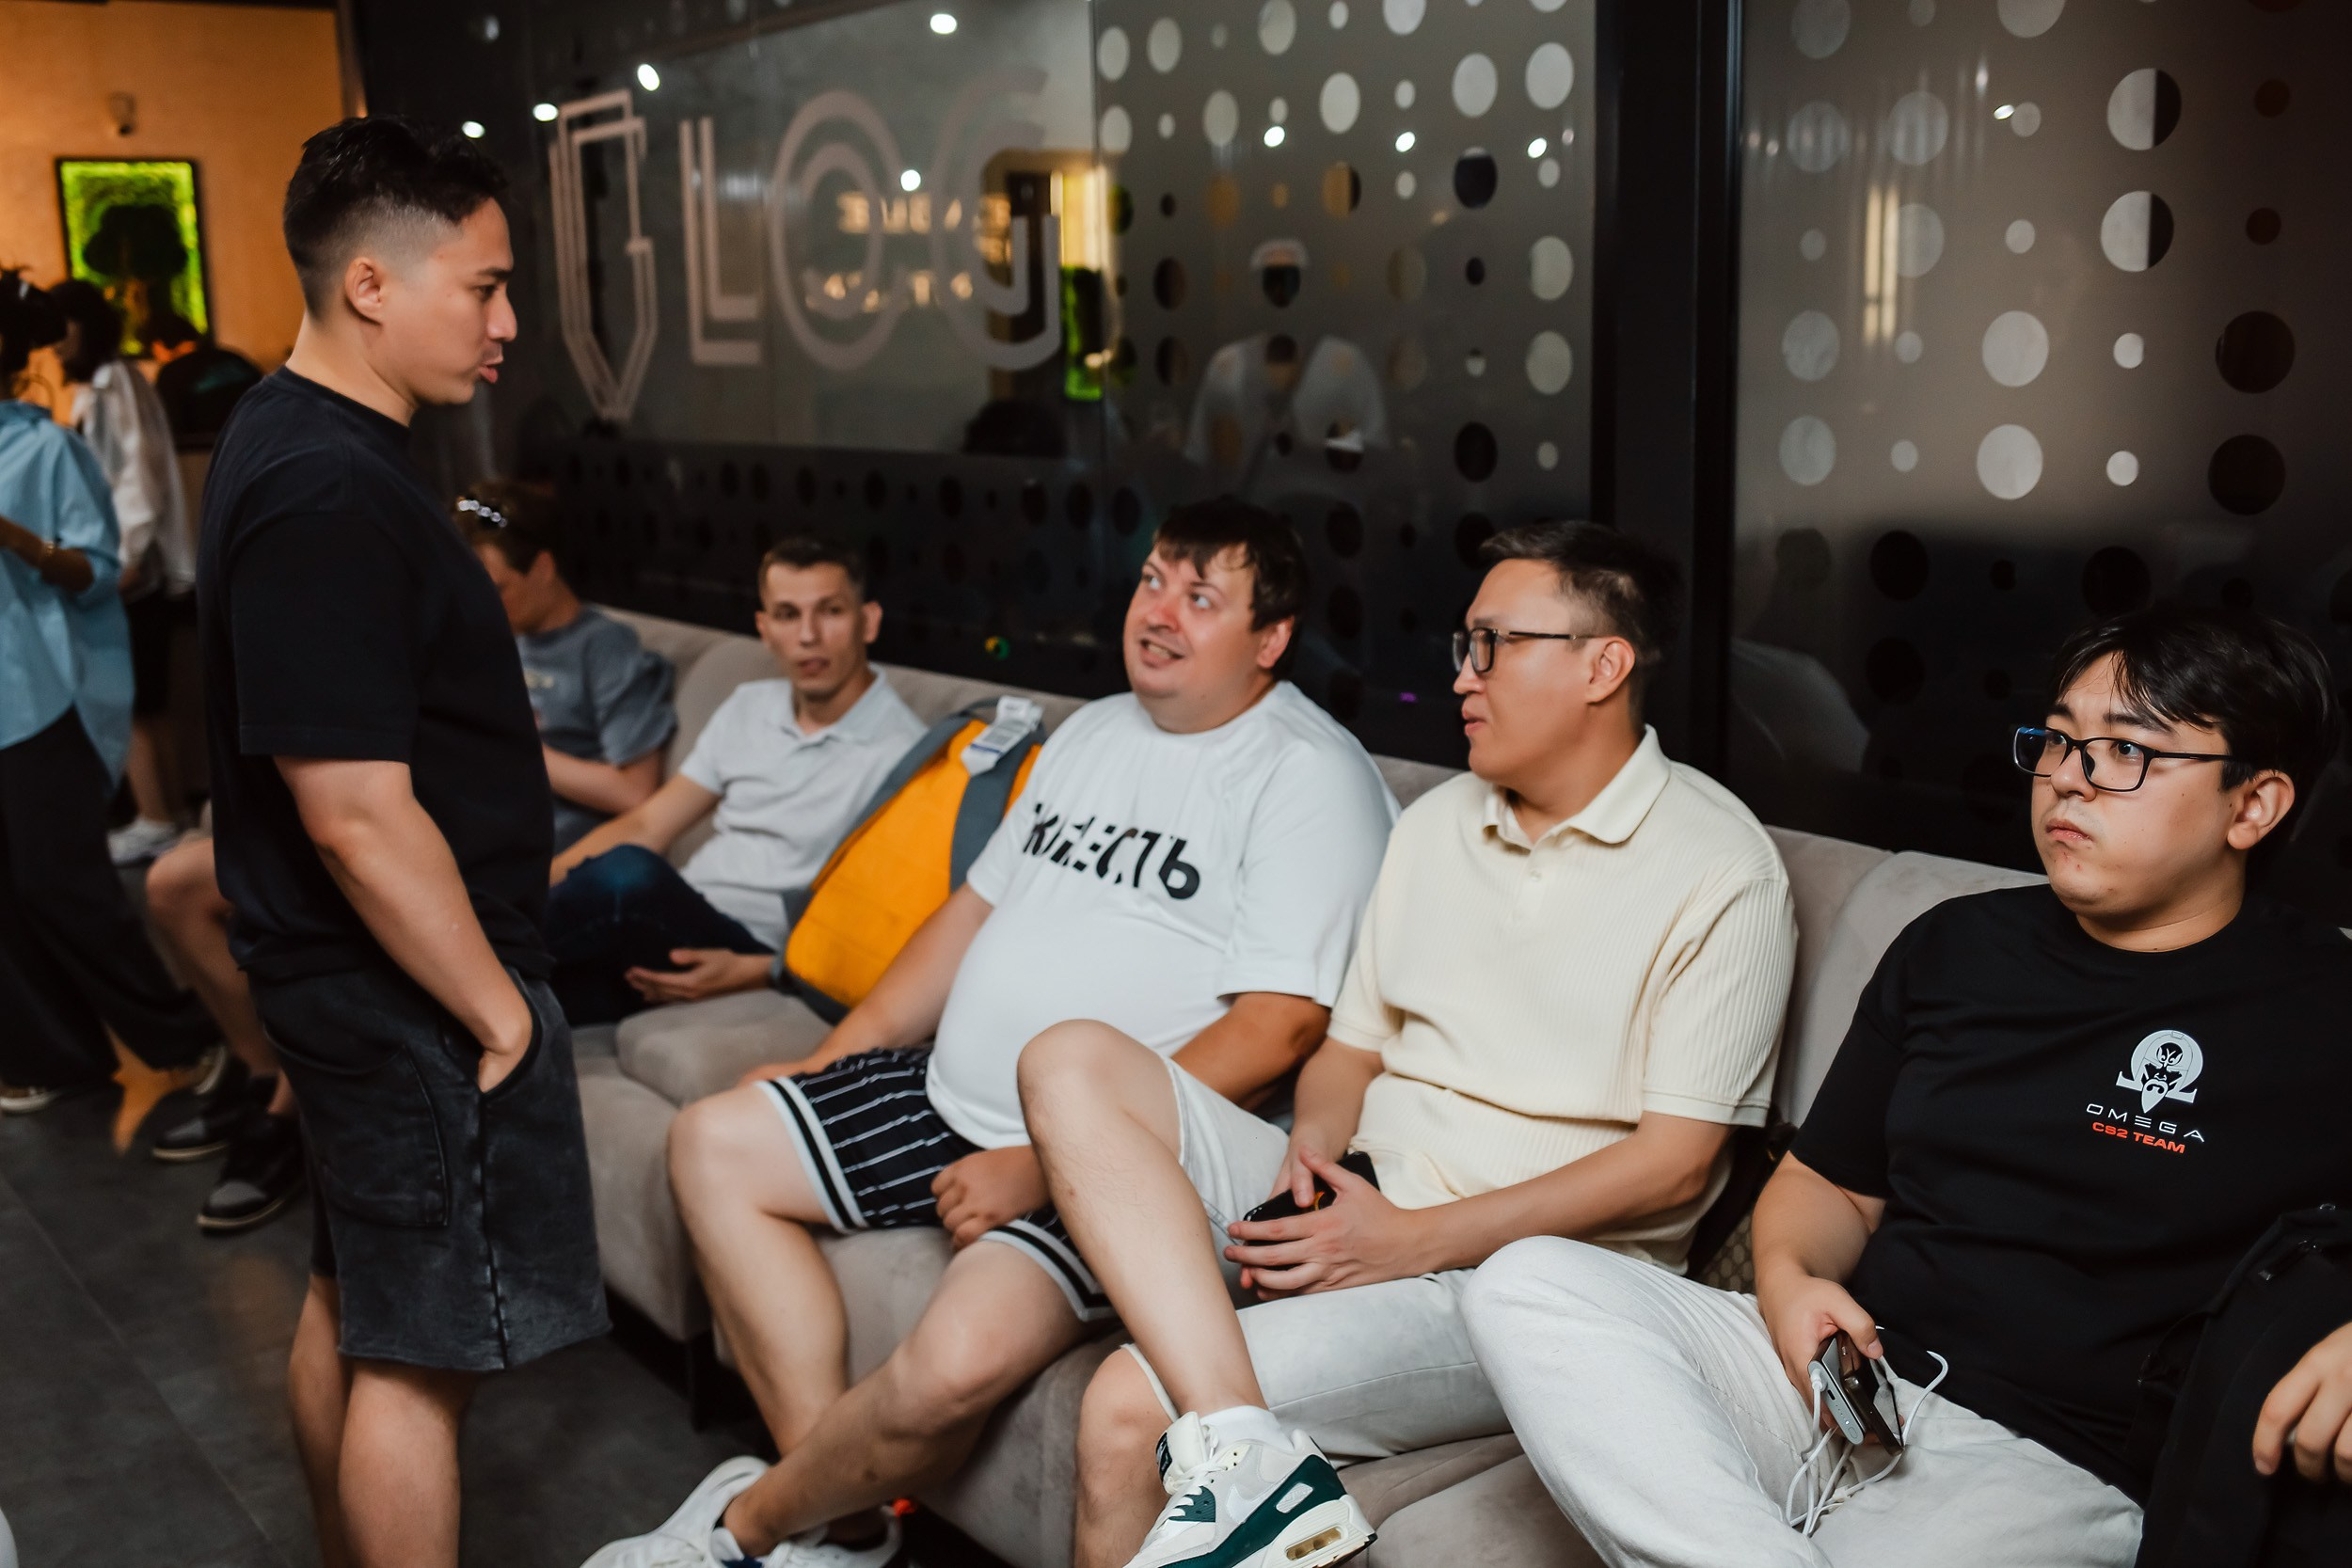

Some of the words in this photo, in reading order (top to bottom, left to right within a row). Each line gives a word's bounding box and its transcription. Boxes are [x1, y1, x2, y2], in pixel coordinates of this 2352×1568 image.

[2086, 1103, 2204, 1143] OMEGA
[2092, 1122, 2128, 1139] CS2
[2133, 1132, 2185, 1154] TEAM
